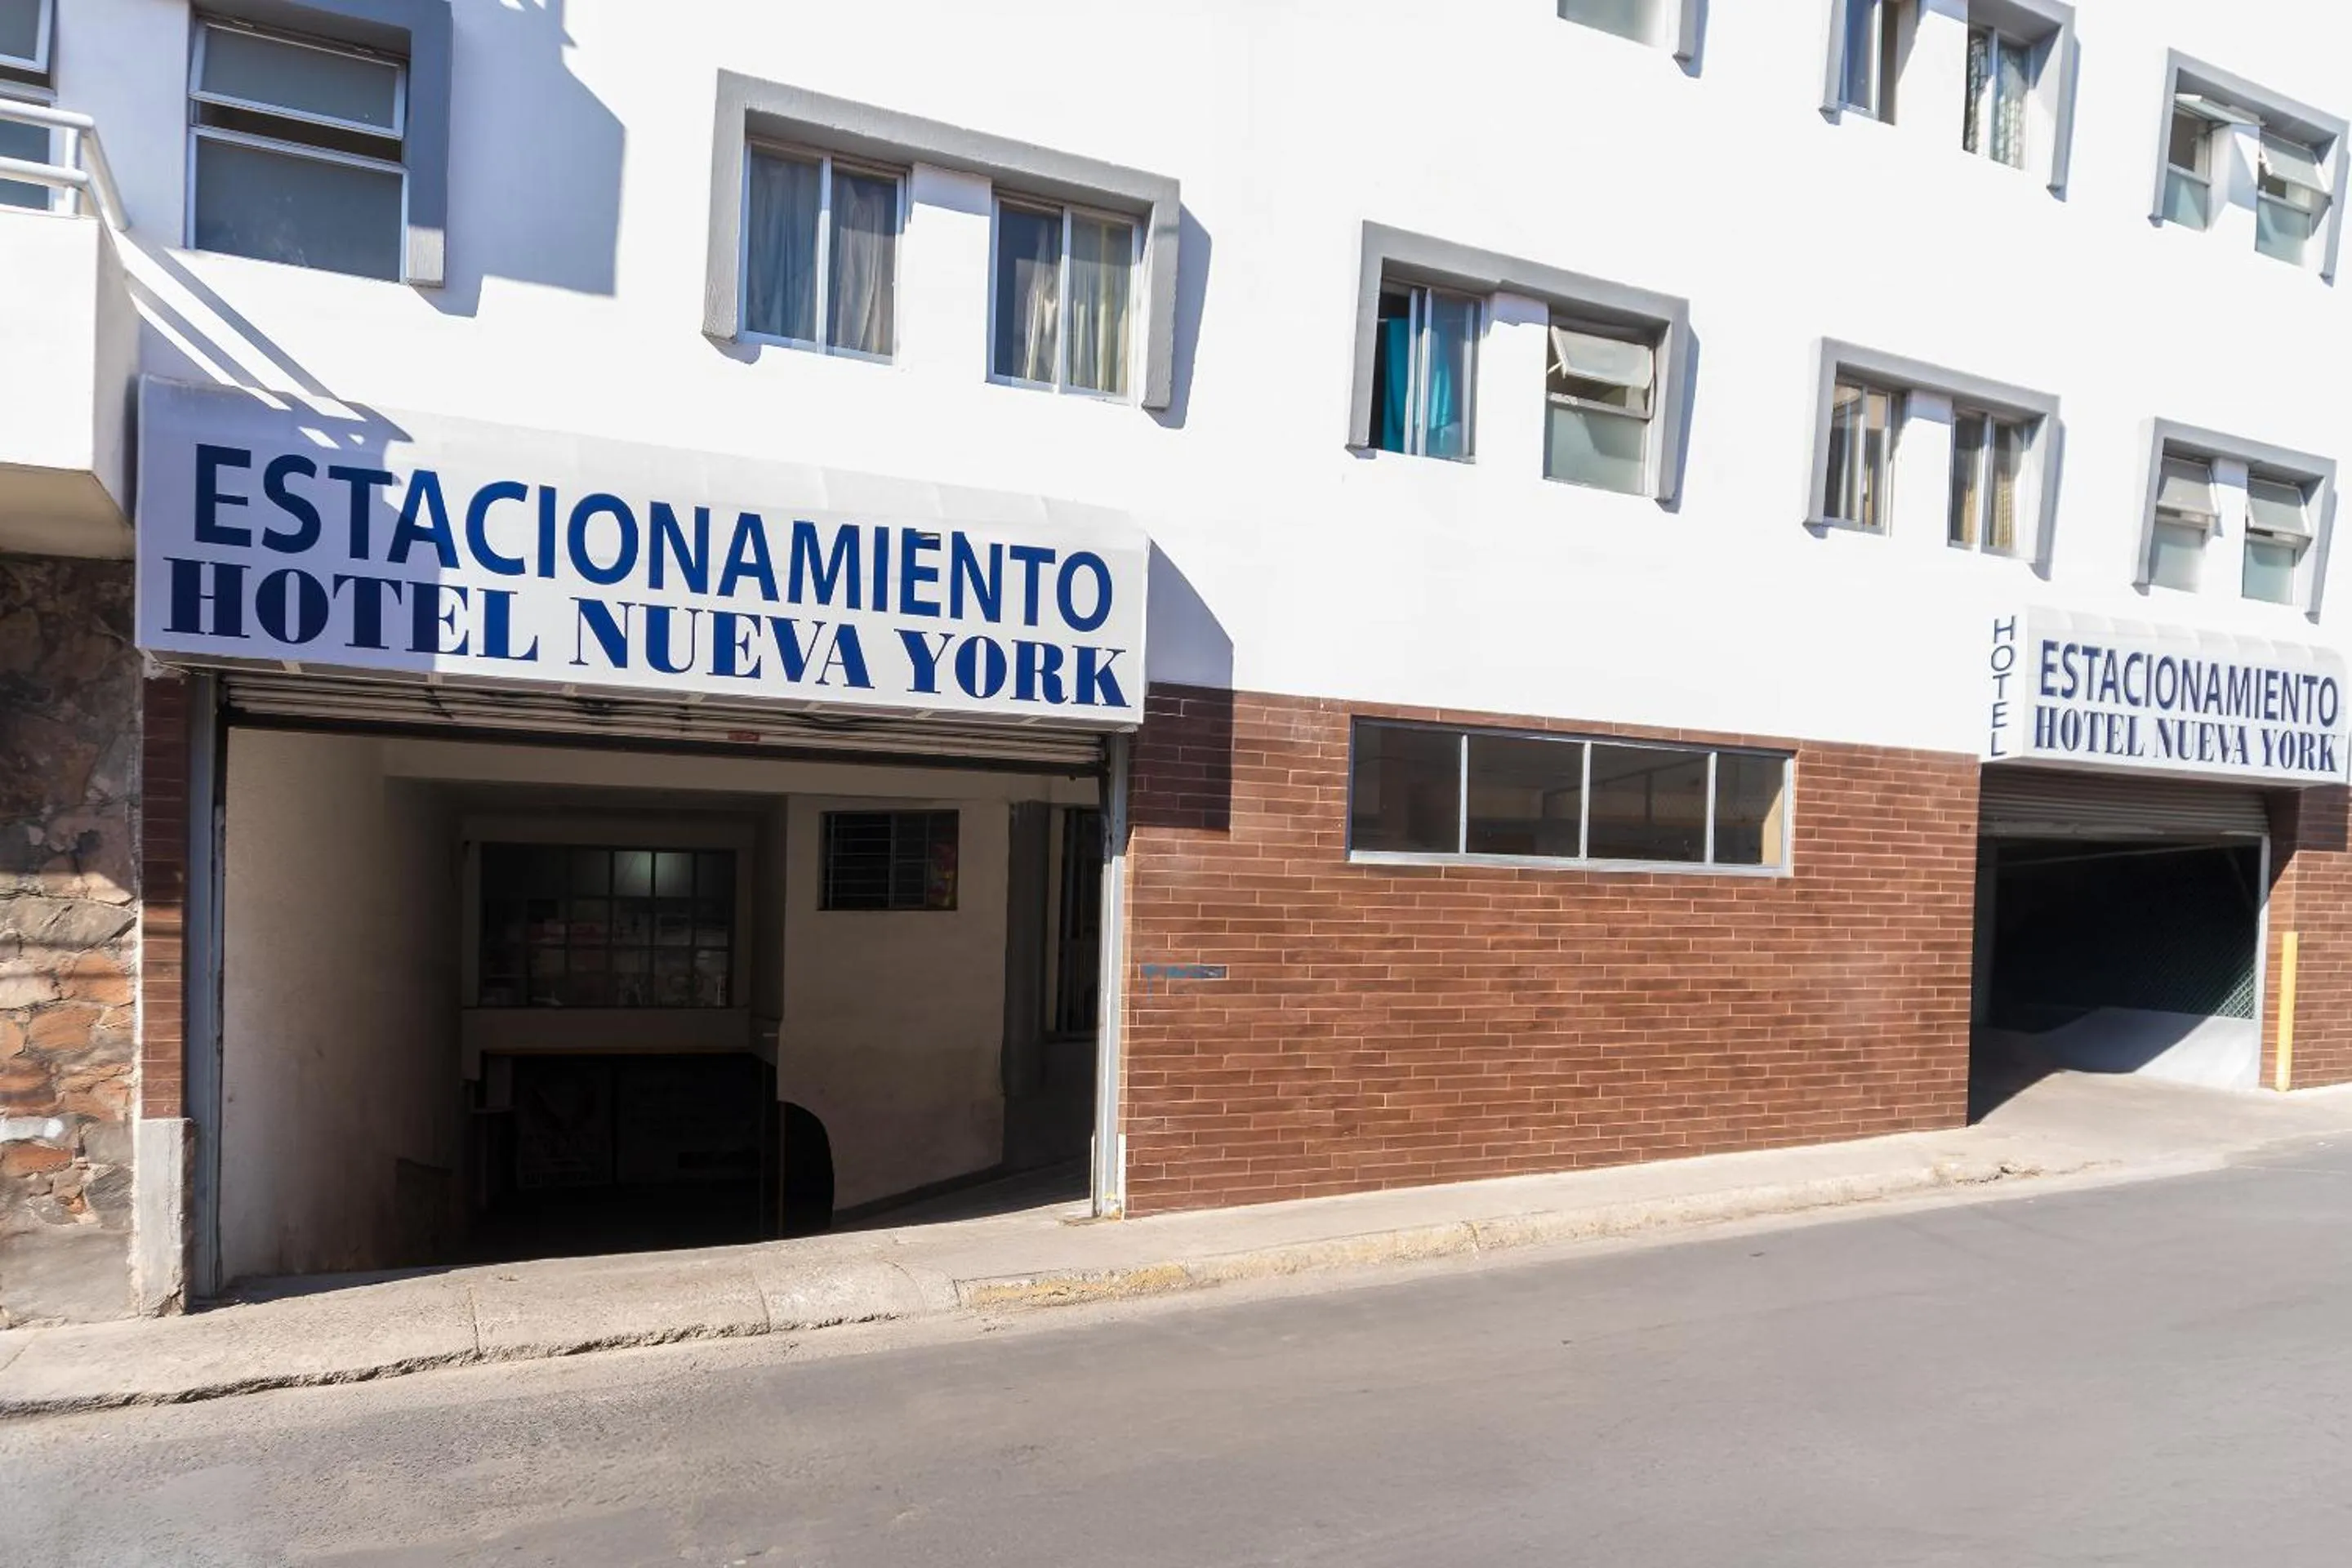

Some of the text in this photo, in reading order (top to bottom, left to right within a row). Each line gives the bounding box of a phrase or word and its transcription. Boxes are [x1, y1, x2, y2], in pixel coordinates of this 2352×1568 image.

[194, 443, 1112, 632] ESTACIONAMIENTO
[162, 556, 1132, 708] HOTEL NUEVA YORK
[1990, 615, 2016, 757] HOTEL
[2040, 639, 2338, 728] ESTACIONAMIENTO
[2034, 705, 2337, 773] HOTEL NUEVA YORK
